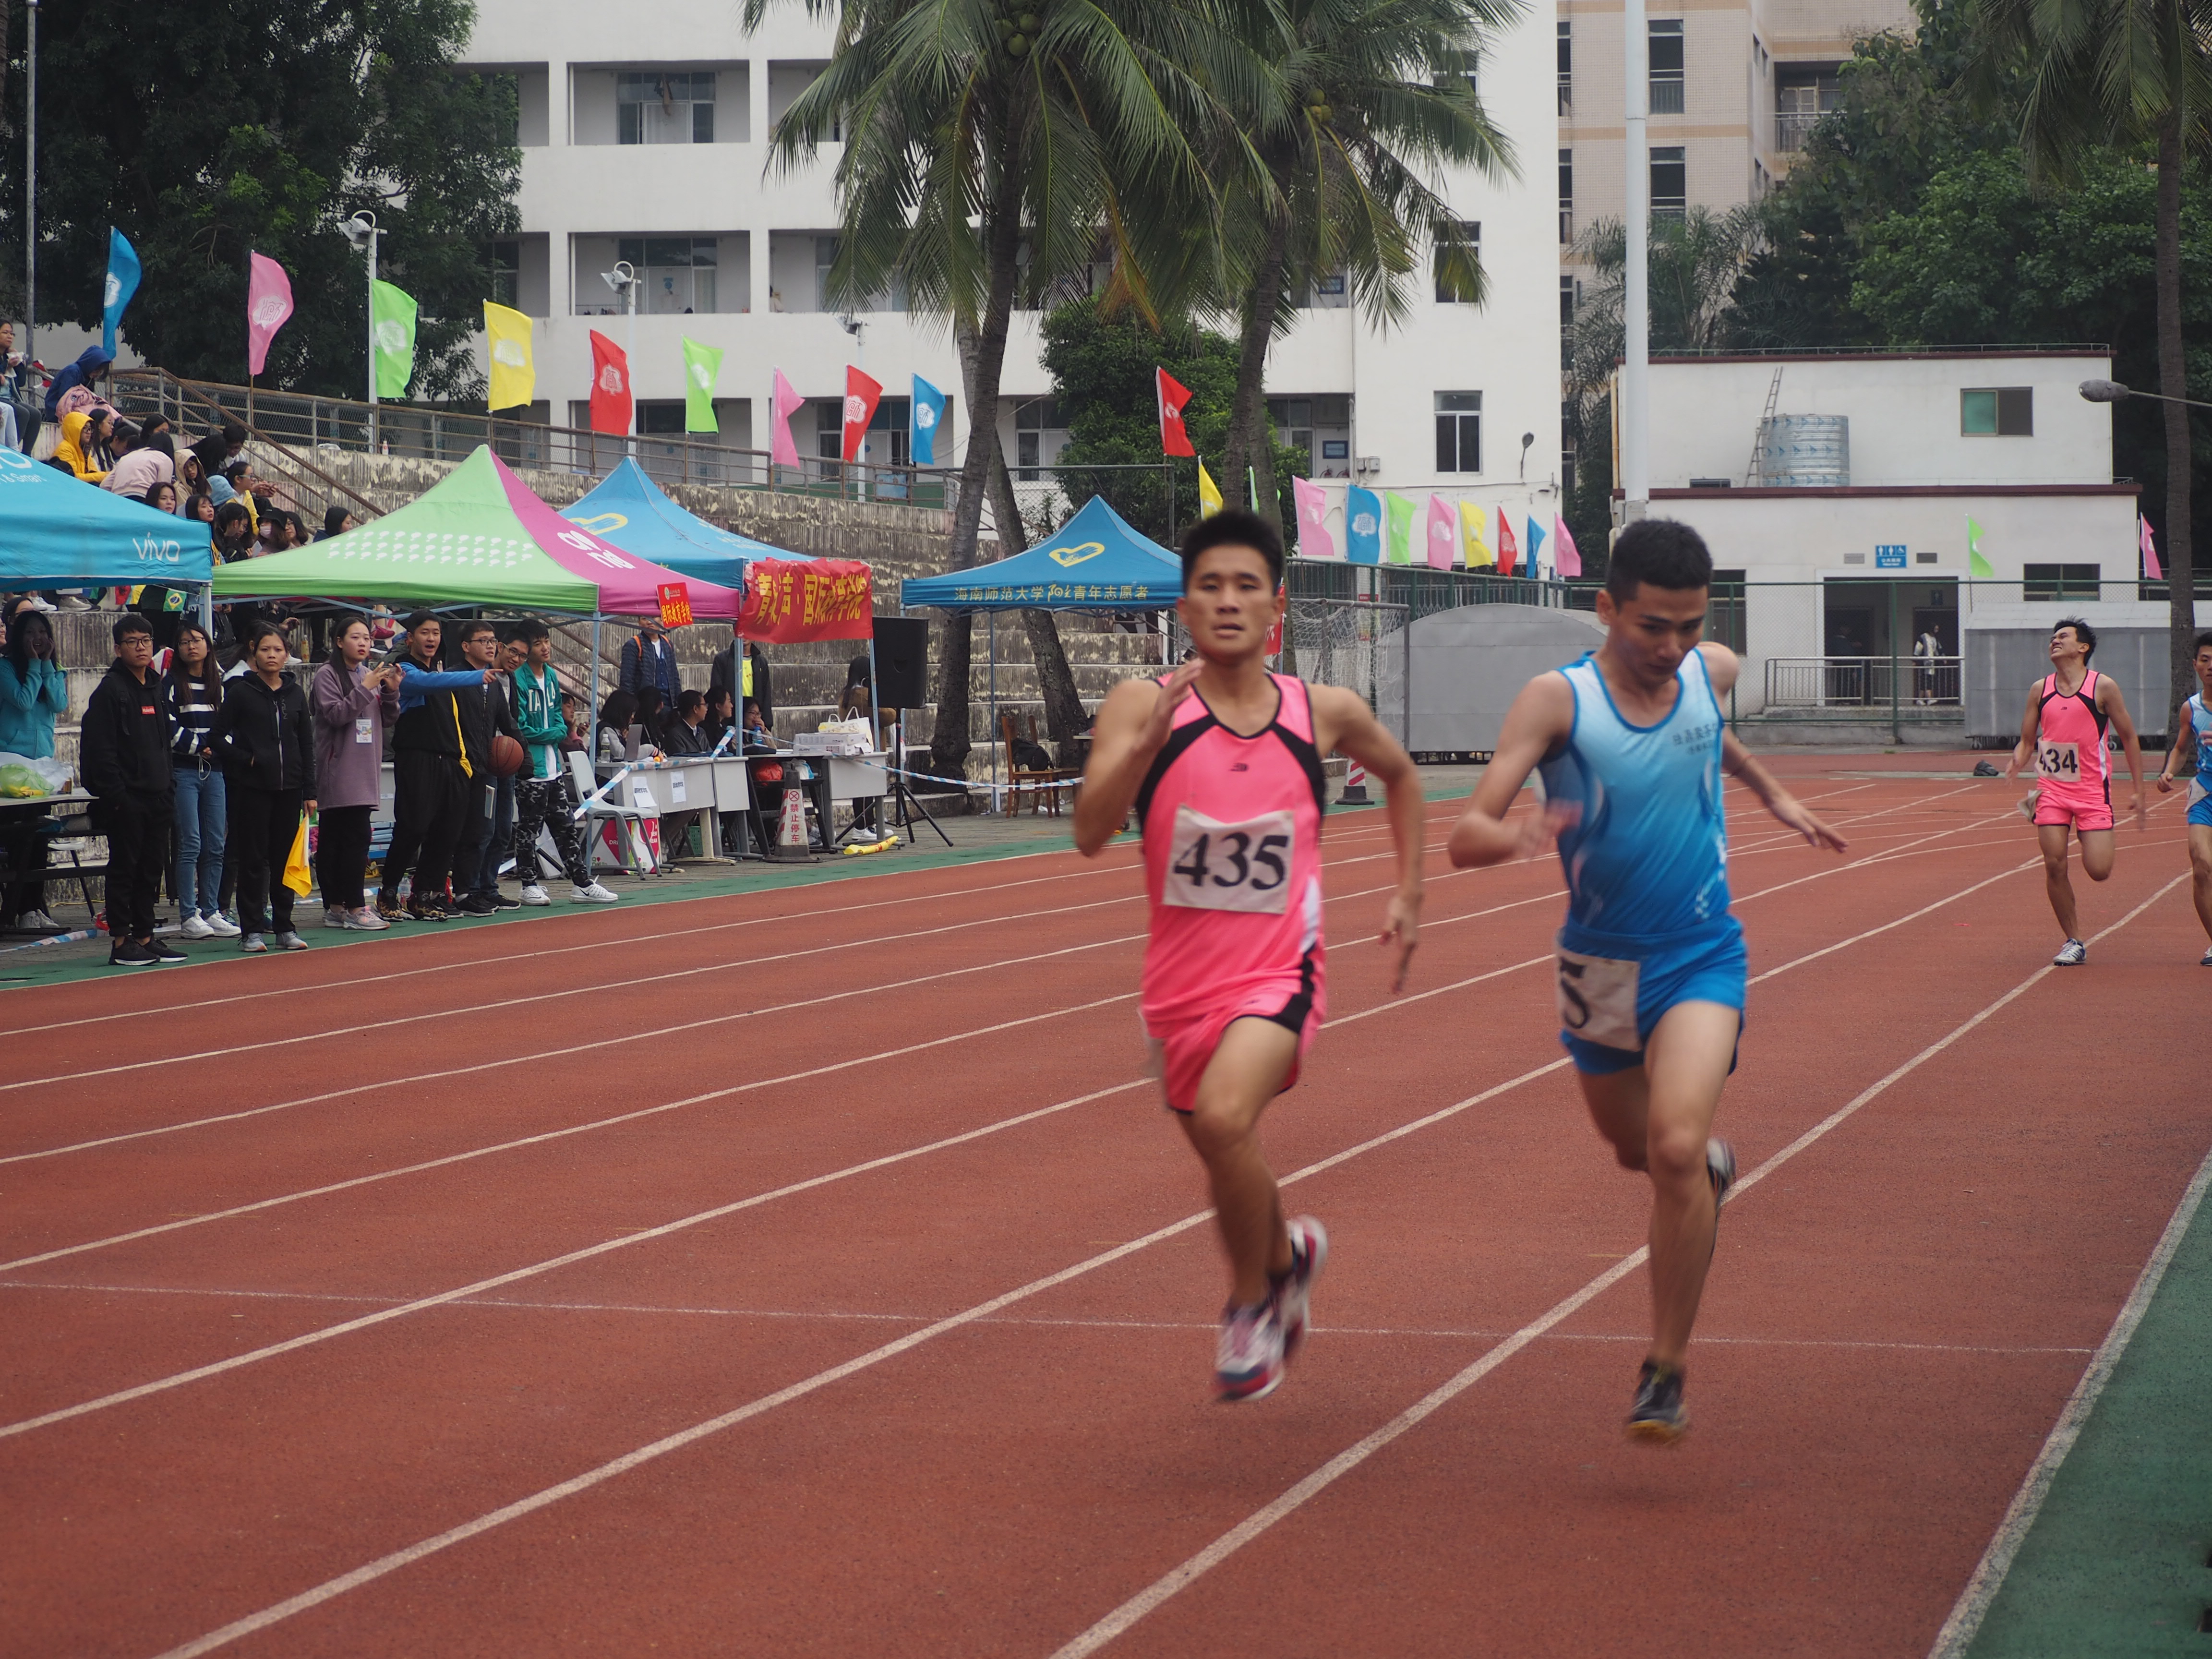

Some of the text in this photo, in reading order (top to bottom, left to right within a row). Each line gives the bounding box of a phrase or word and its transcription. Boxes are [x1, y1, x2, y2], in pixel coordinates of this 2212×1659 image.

[2039, 748, 2078, 773] 434
[790, 804, 799, 843] 禁止停车
[1173, 832, 1289, 890] 435
